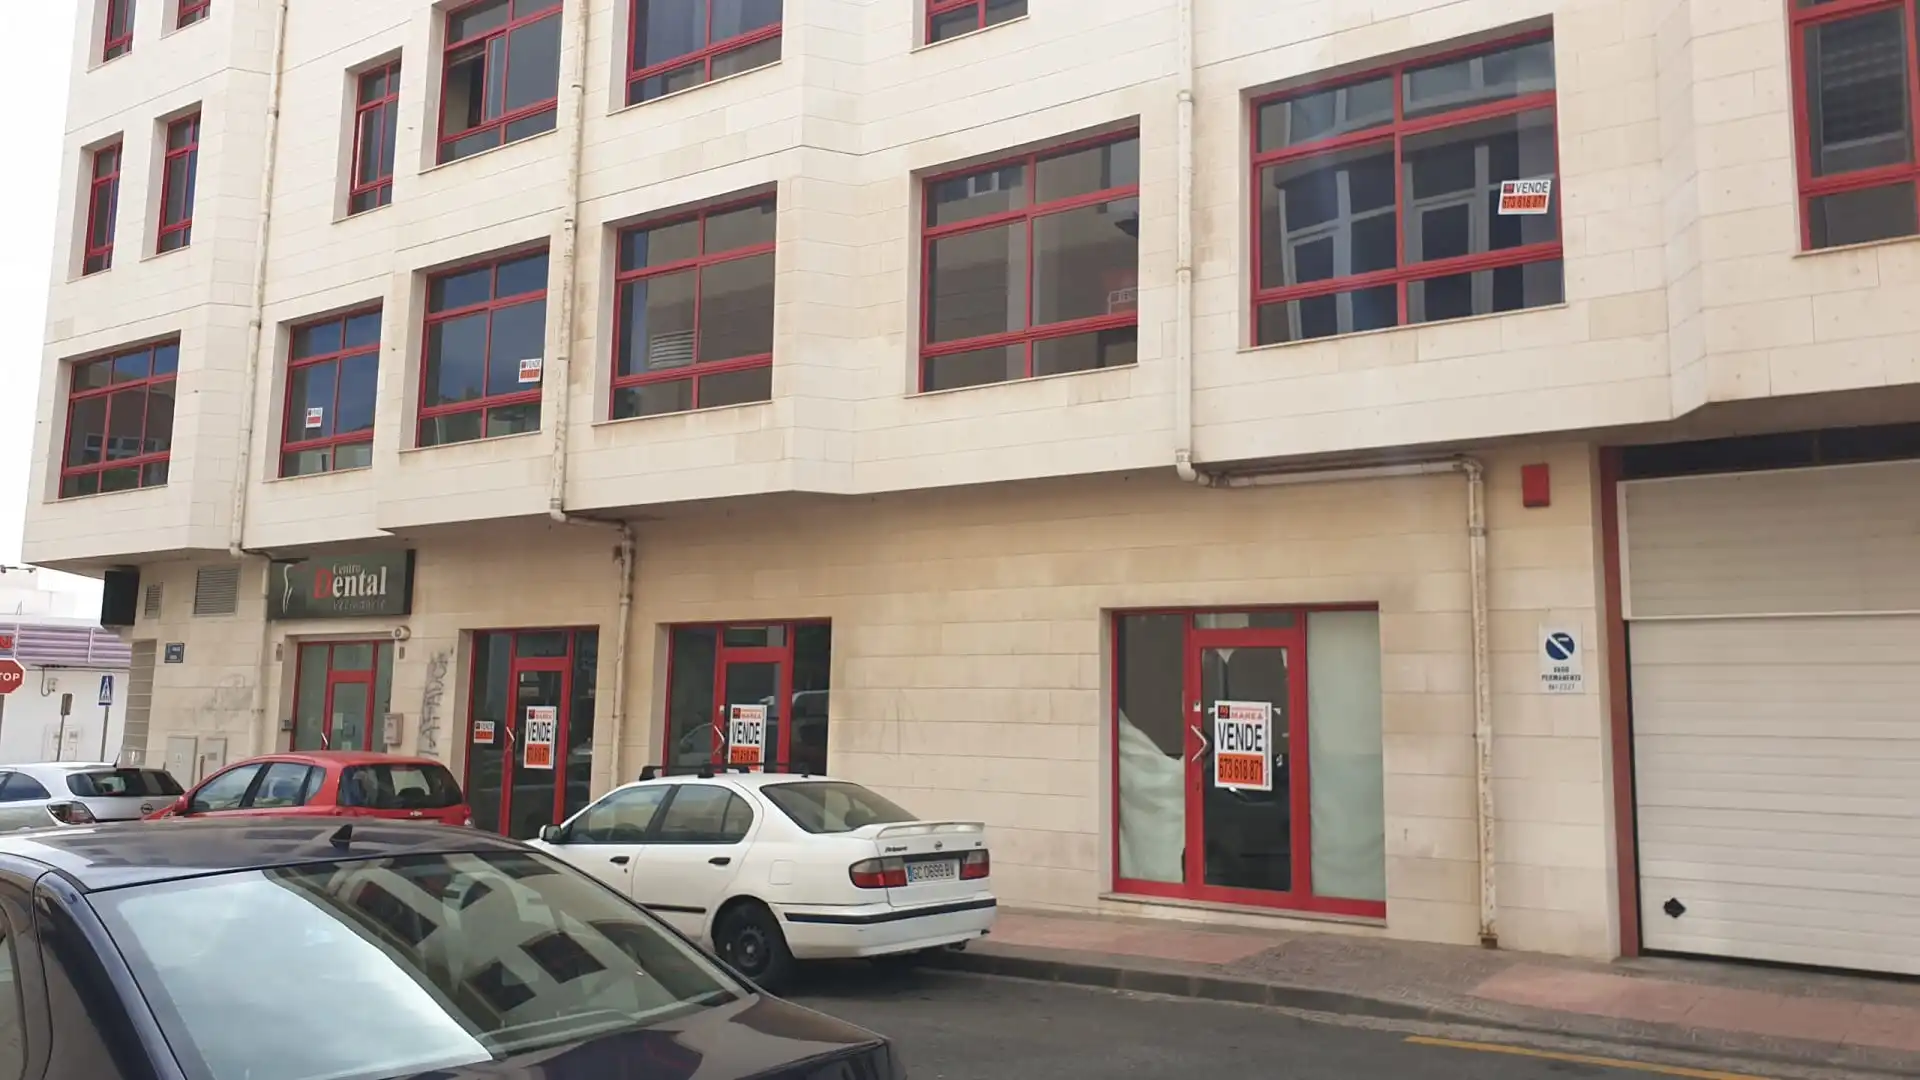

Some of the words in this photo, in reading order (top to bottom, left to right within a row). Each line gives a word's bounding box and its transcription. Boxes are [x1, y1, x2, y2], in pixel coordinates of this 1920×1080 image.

[1516, 182, 1549, 193] VENDE
[333, 564, 361, 575] Centro
[313, 566, 387, 600] Dental
[0, 672, 20, 682] TOP
[528, 721, 551, 741] VENDE
[732, 721, 760, 744] VENDE
[1218, 722, 1262, 751] VENDE
[1219, 758, 1233, 778] 673
[1234, 759, 1248, 780] 618
